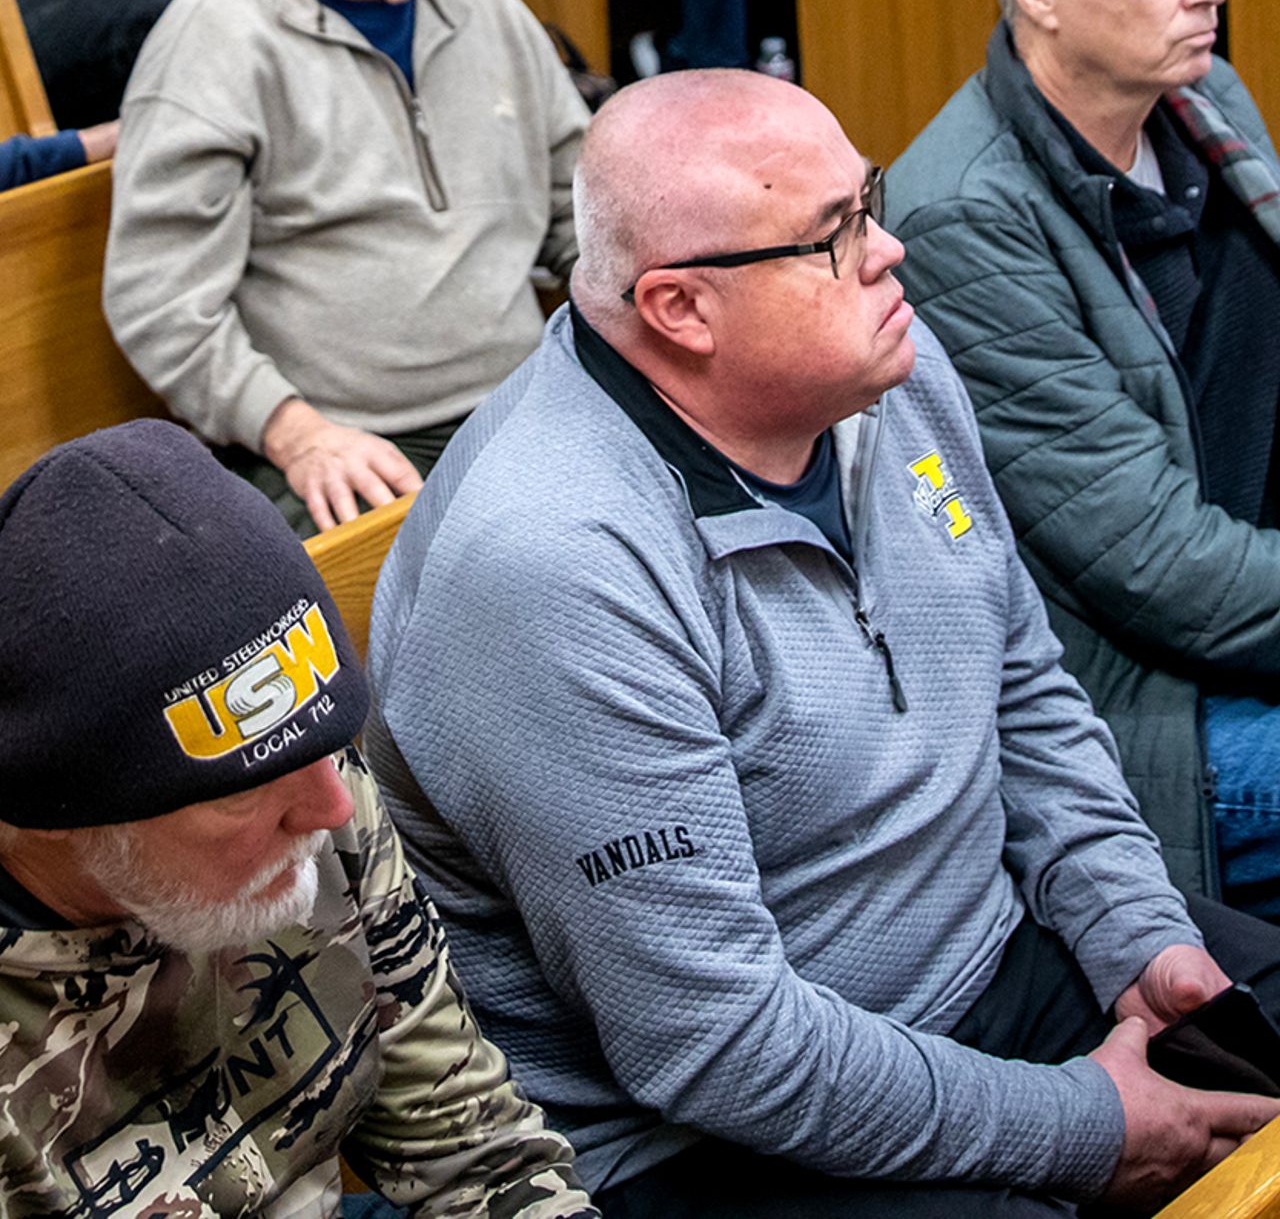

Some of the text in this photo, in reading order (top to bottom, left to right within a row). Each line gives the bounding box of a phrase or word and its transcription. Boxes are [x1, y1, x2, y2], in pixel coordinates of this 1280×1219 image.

[163, 602, 340, 760] USW
[164, 667, 219, 702] UNITED
[240, 694, 336, 768] LOCAL 712
[575, 826, 695, 887] VANDALS
